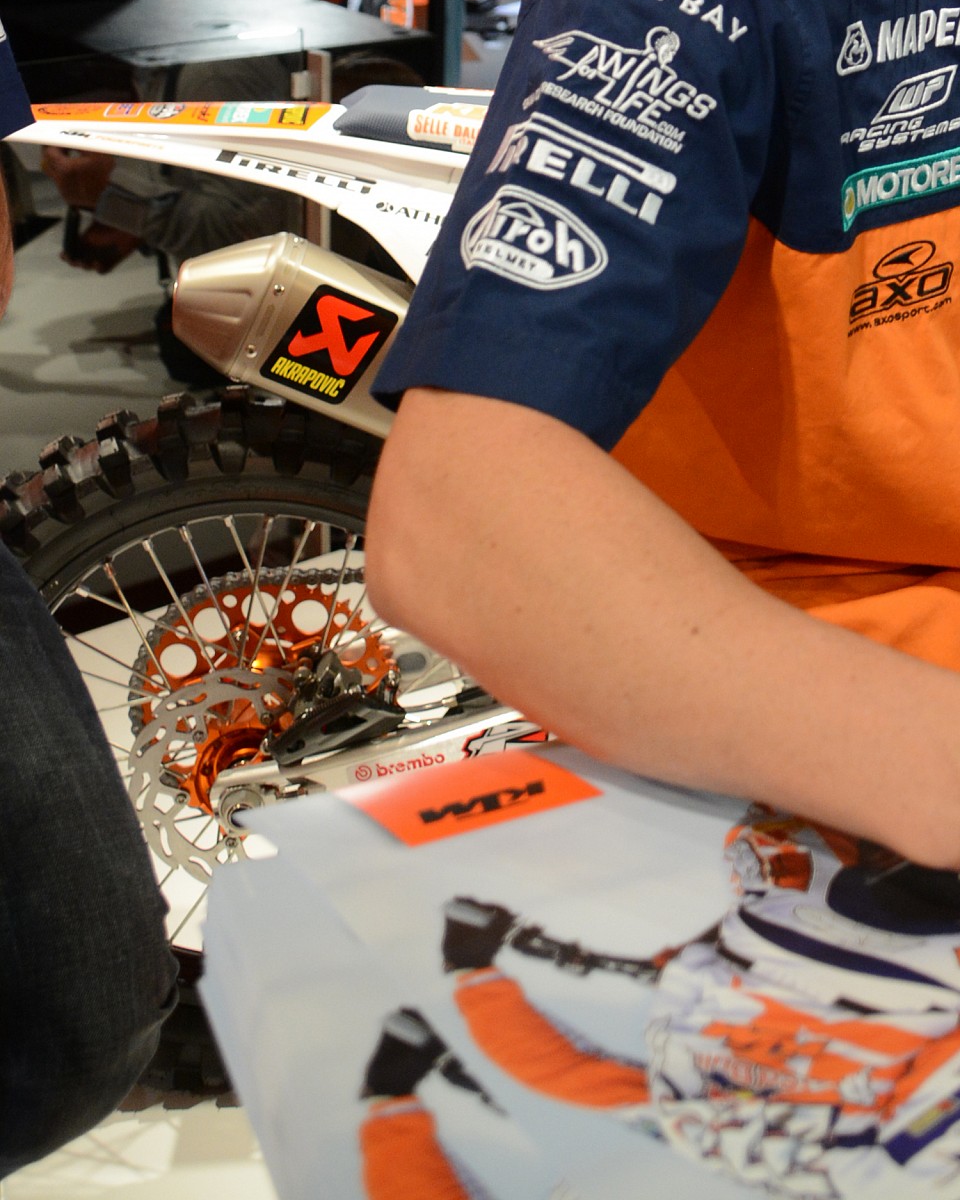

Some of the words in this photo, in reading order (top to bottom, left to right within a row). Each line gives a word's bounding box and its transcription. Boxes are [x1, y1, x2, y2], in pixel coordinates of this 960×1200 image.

[597, 44, 717, 120] WINGS
[414, 114, 448, 136] SELLE
[454, 124, 482, 139] DAL
[603, 108, 684, 155] FOUNDATION
[216, 150, 377, 195] PIRELLI
[376, 753, 445, 778] brembo
[418, 780, 546, 824] KTM
